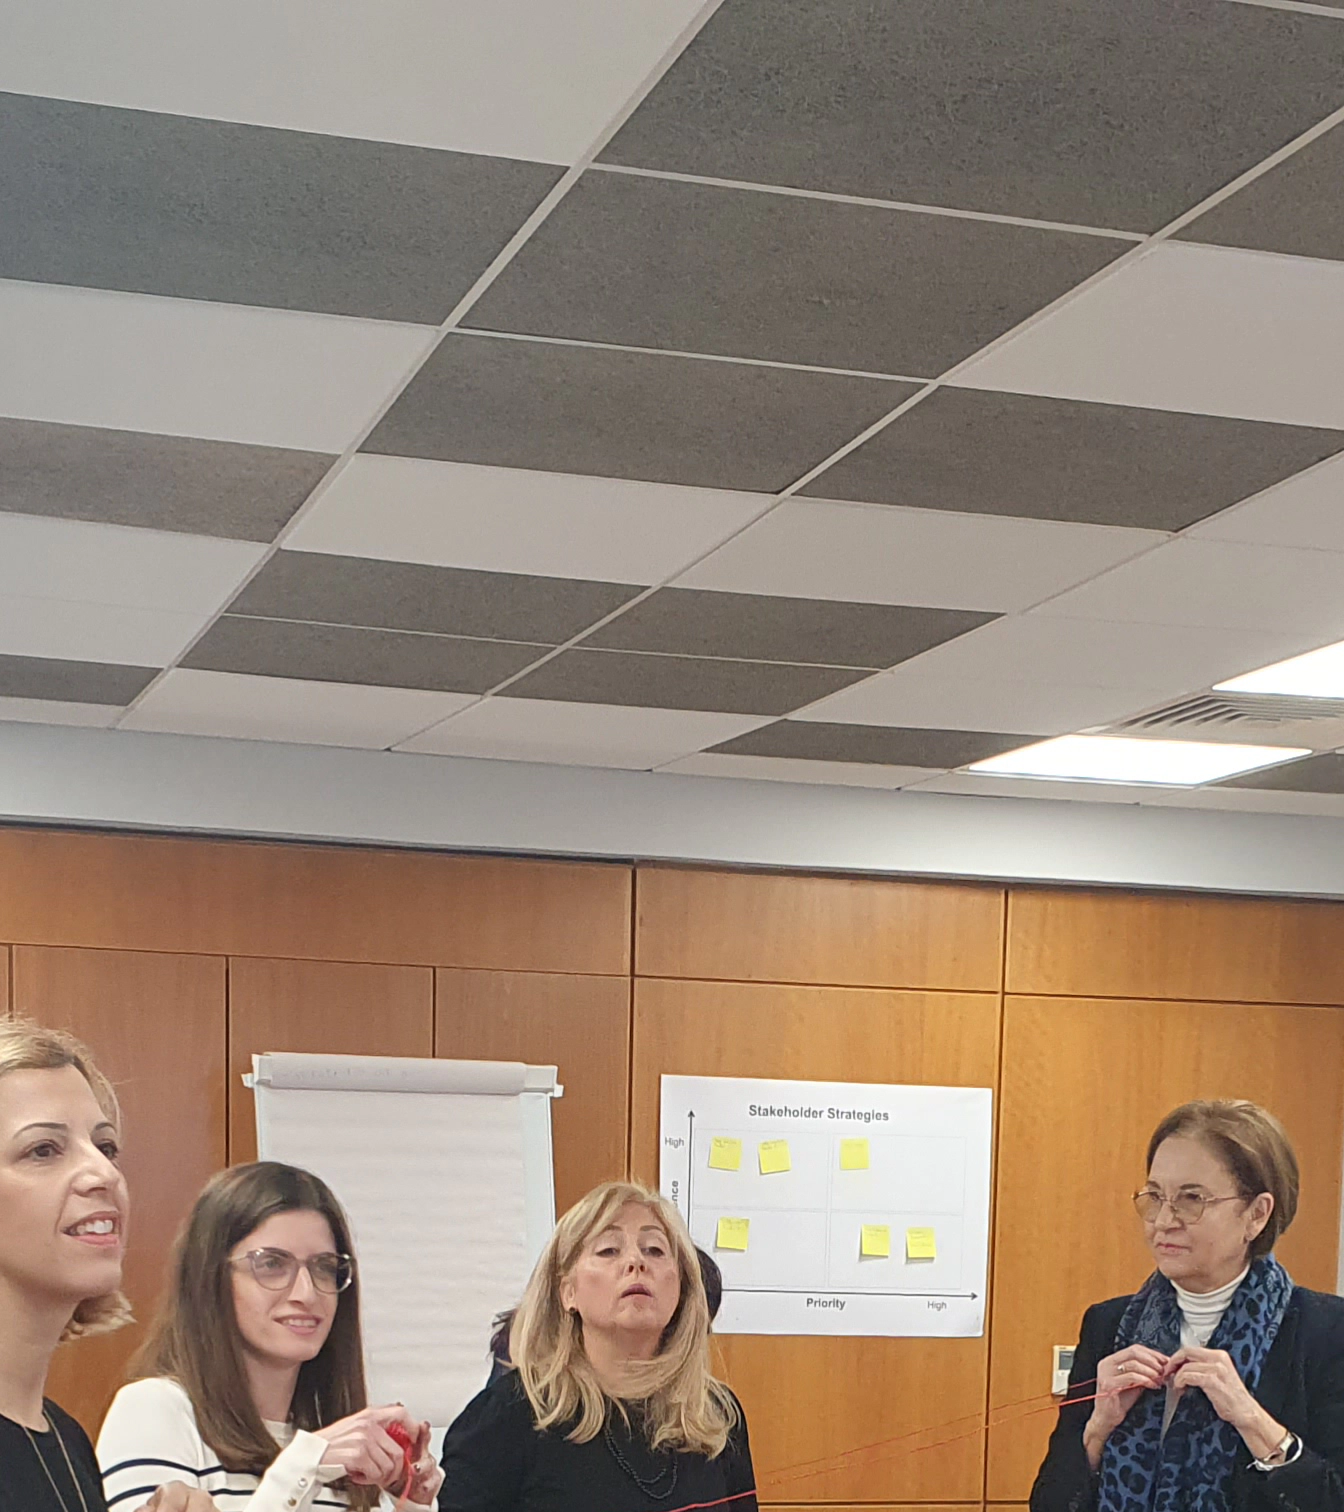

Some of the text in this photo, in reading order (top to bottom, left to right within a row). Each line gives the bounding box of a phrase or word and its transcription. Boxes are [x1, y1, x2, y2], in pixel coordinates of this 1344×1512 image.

[748, 1104, 889, 1123] Stakeholder Strategies
[664, 1137, 684, 1149] High
[806, 1298, 846, 1311] Priority
[927, 1301, 947, 1311] High
